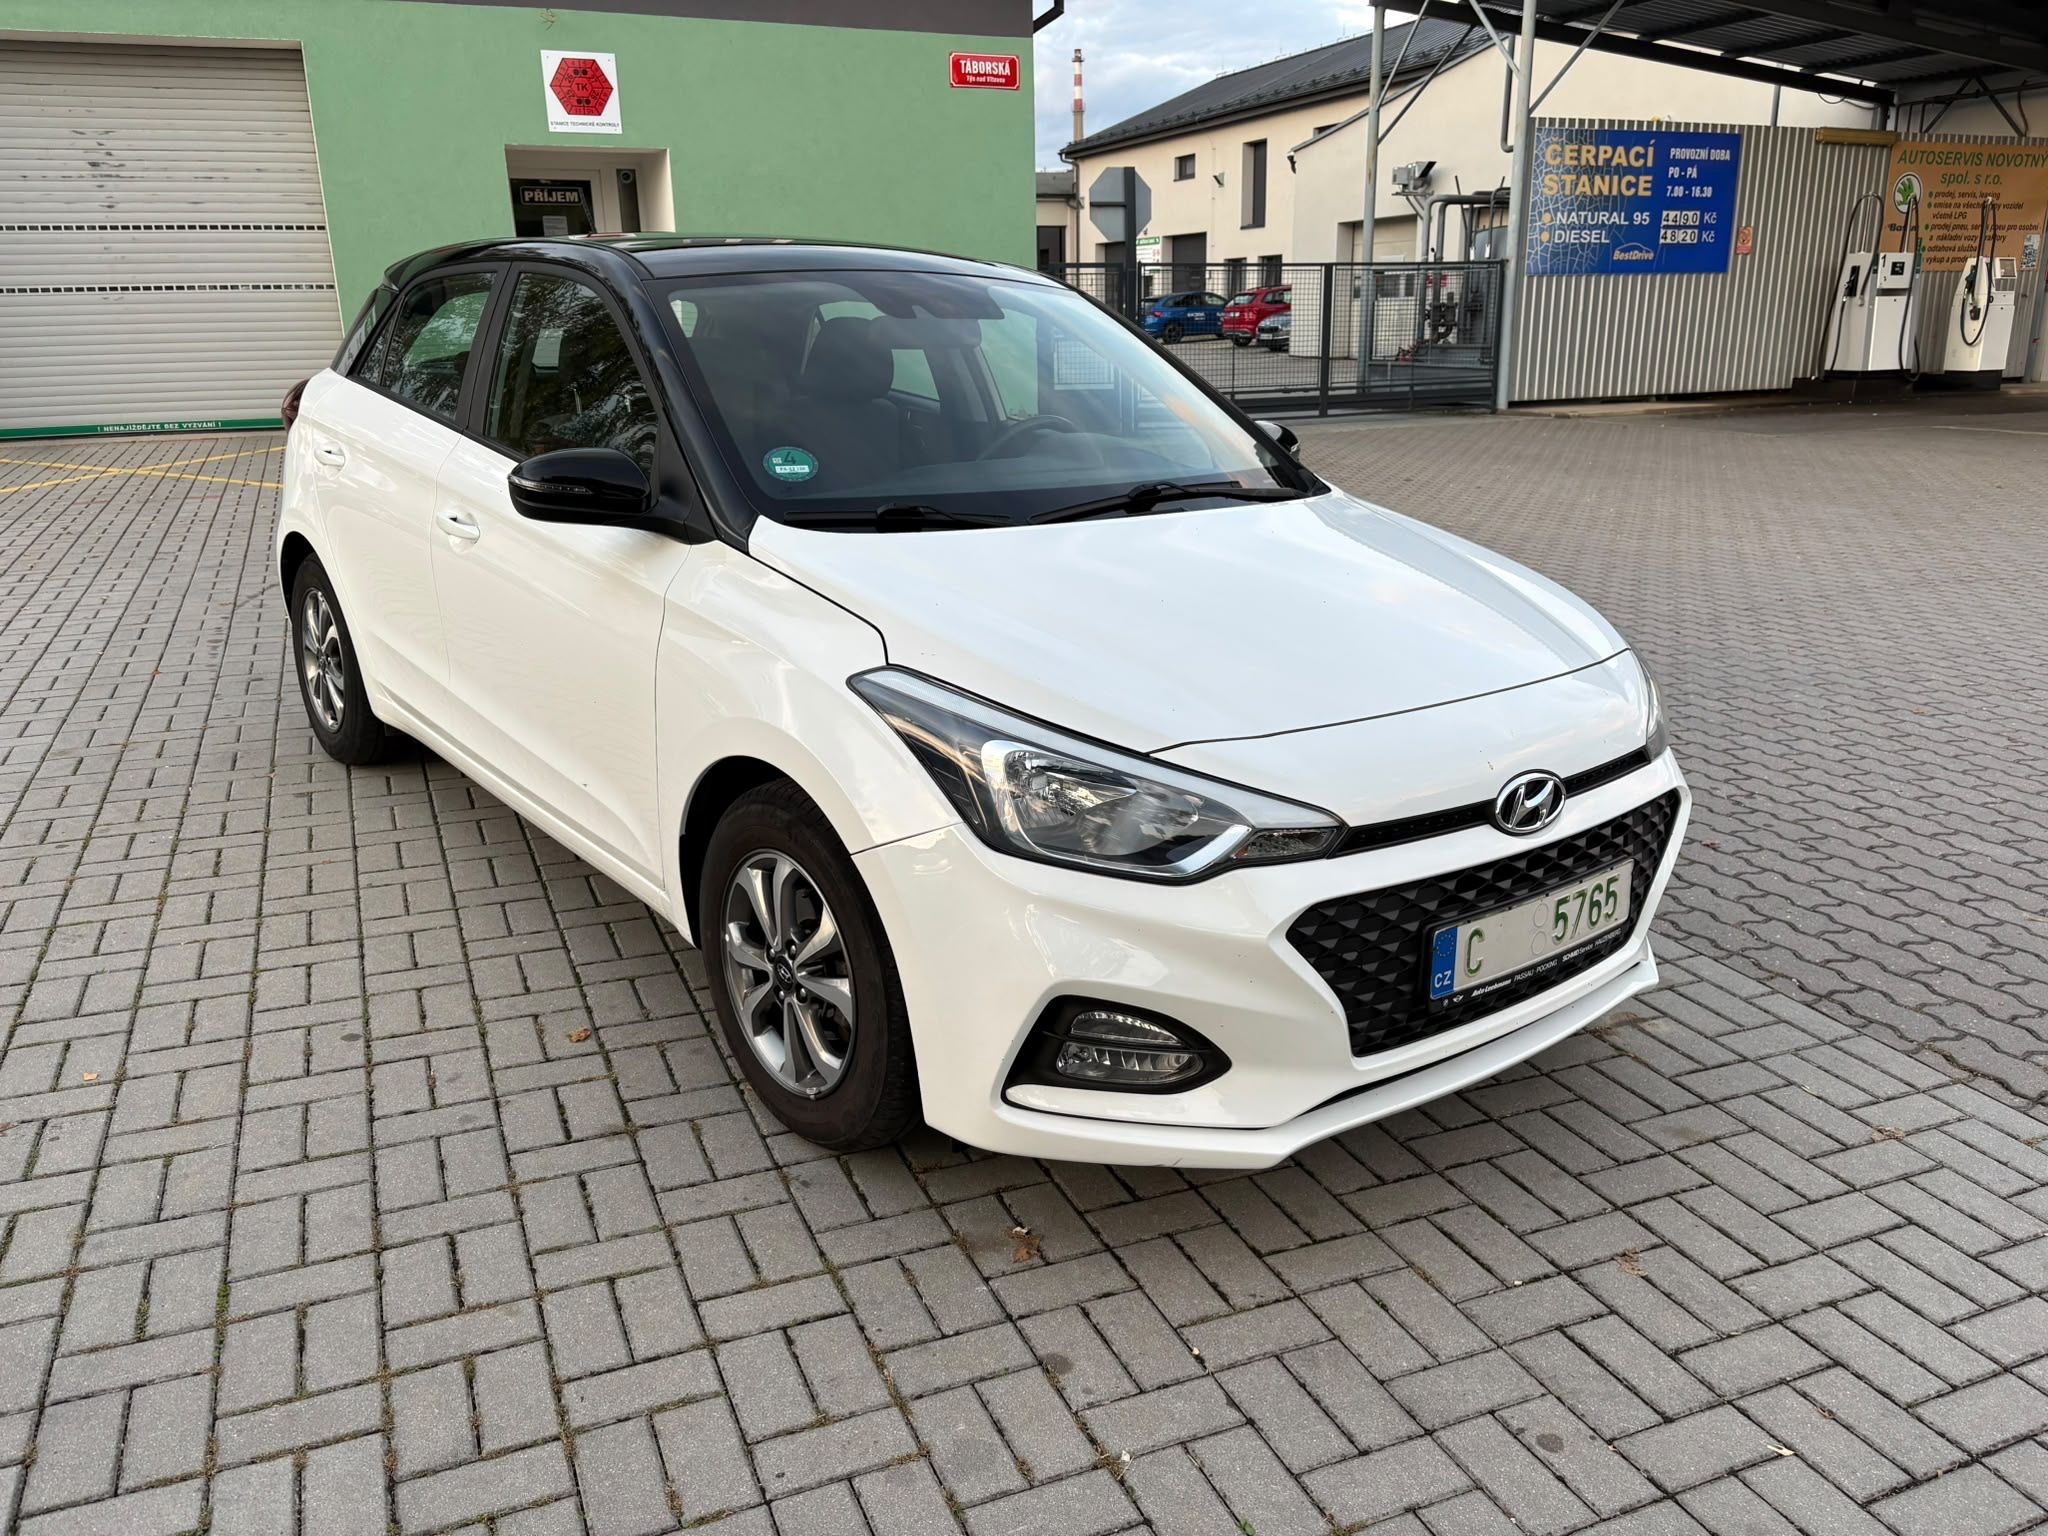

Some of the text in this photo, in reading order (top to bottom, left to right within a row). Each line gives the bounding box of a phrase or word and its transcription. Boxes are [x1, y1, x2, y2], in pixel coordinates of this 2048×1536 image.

[959, 58, 1011, 76] TÁBORSKÁ
[575, 83, 589, 92] TK
[1544, 136, 1656, 168] ČERPACÍ
[1669, 147, 1731, 161] PROVOZNÍ DOBA
[1897, 149, 2048, 168] AUTOSERVIS NOVOTNÝ
[1668, 166, 1680, 178] PO
[1686, 164, 1698, 179] PÁ
[1940, 170, 2003, 187] spol. s r.o.
[1542, 174, 1653, 197] STANICE
[524, 188, 579, 203] PŘÍJEM
[1556, 211, 1650, 225] NATURAL 95
[1703, 211, 1717, 225] Kč
[1953, 211, 1968, 220] LPG
[1930, 223, 1952, 231] prodej
[2005, 224, 2018, 232] pro
[1554, 230, 1611, 244] DIESEL
[1701, 230, 1716, 243] Kč
[1613, 249, 1655, 260] BestDrive
[1881, 254, 1887, 268] 1
[103, 423, 161, 432] NENAJÍŽDĚJTE
[181, 421, 216, 429] VYZVÁNÍ
[783, 451, 797, 464] 4
[1465, 874, 1620, 977] C 5765
[1434, 969, 1452, 988] CZ
